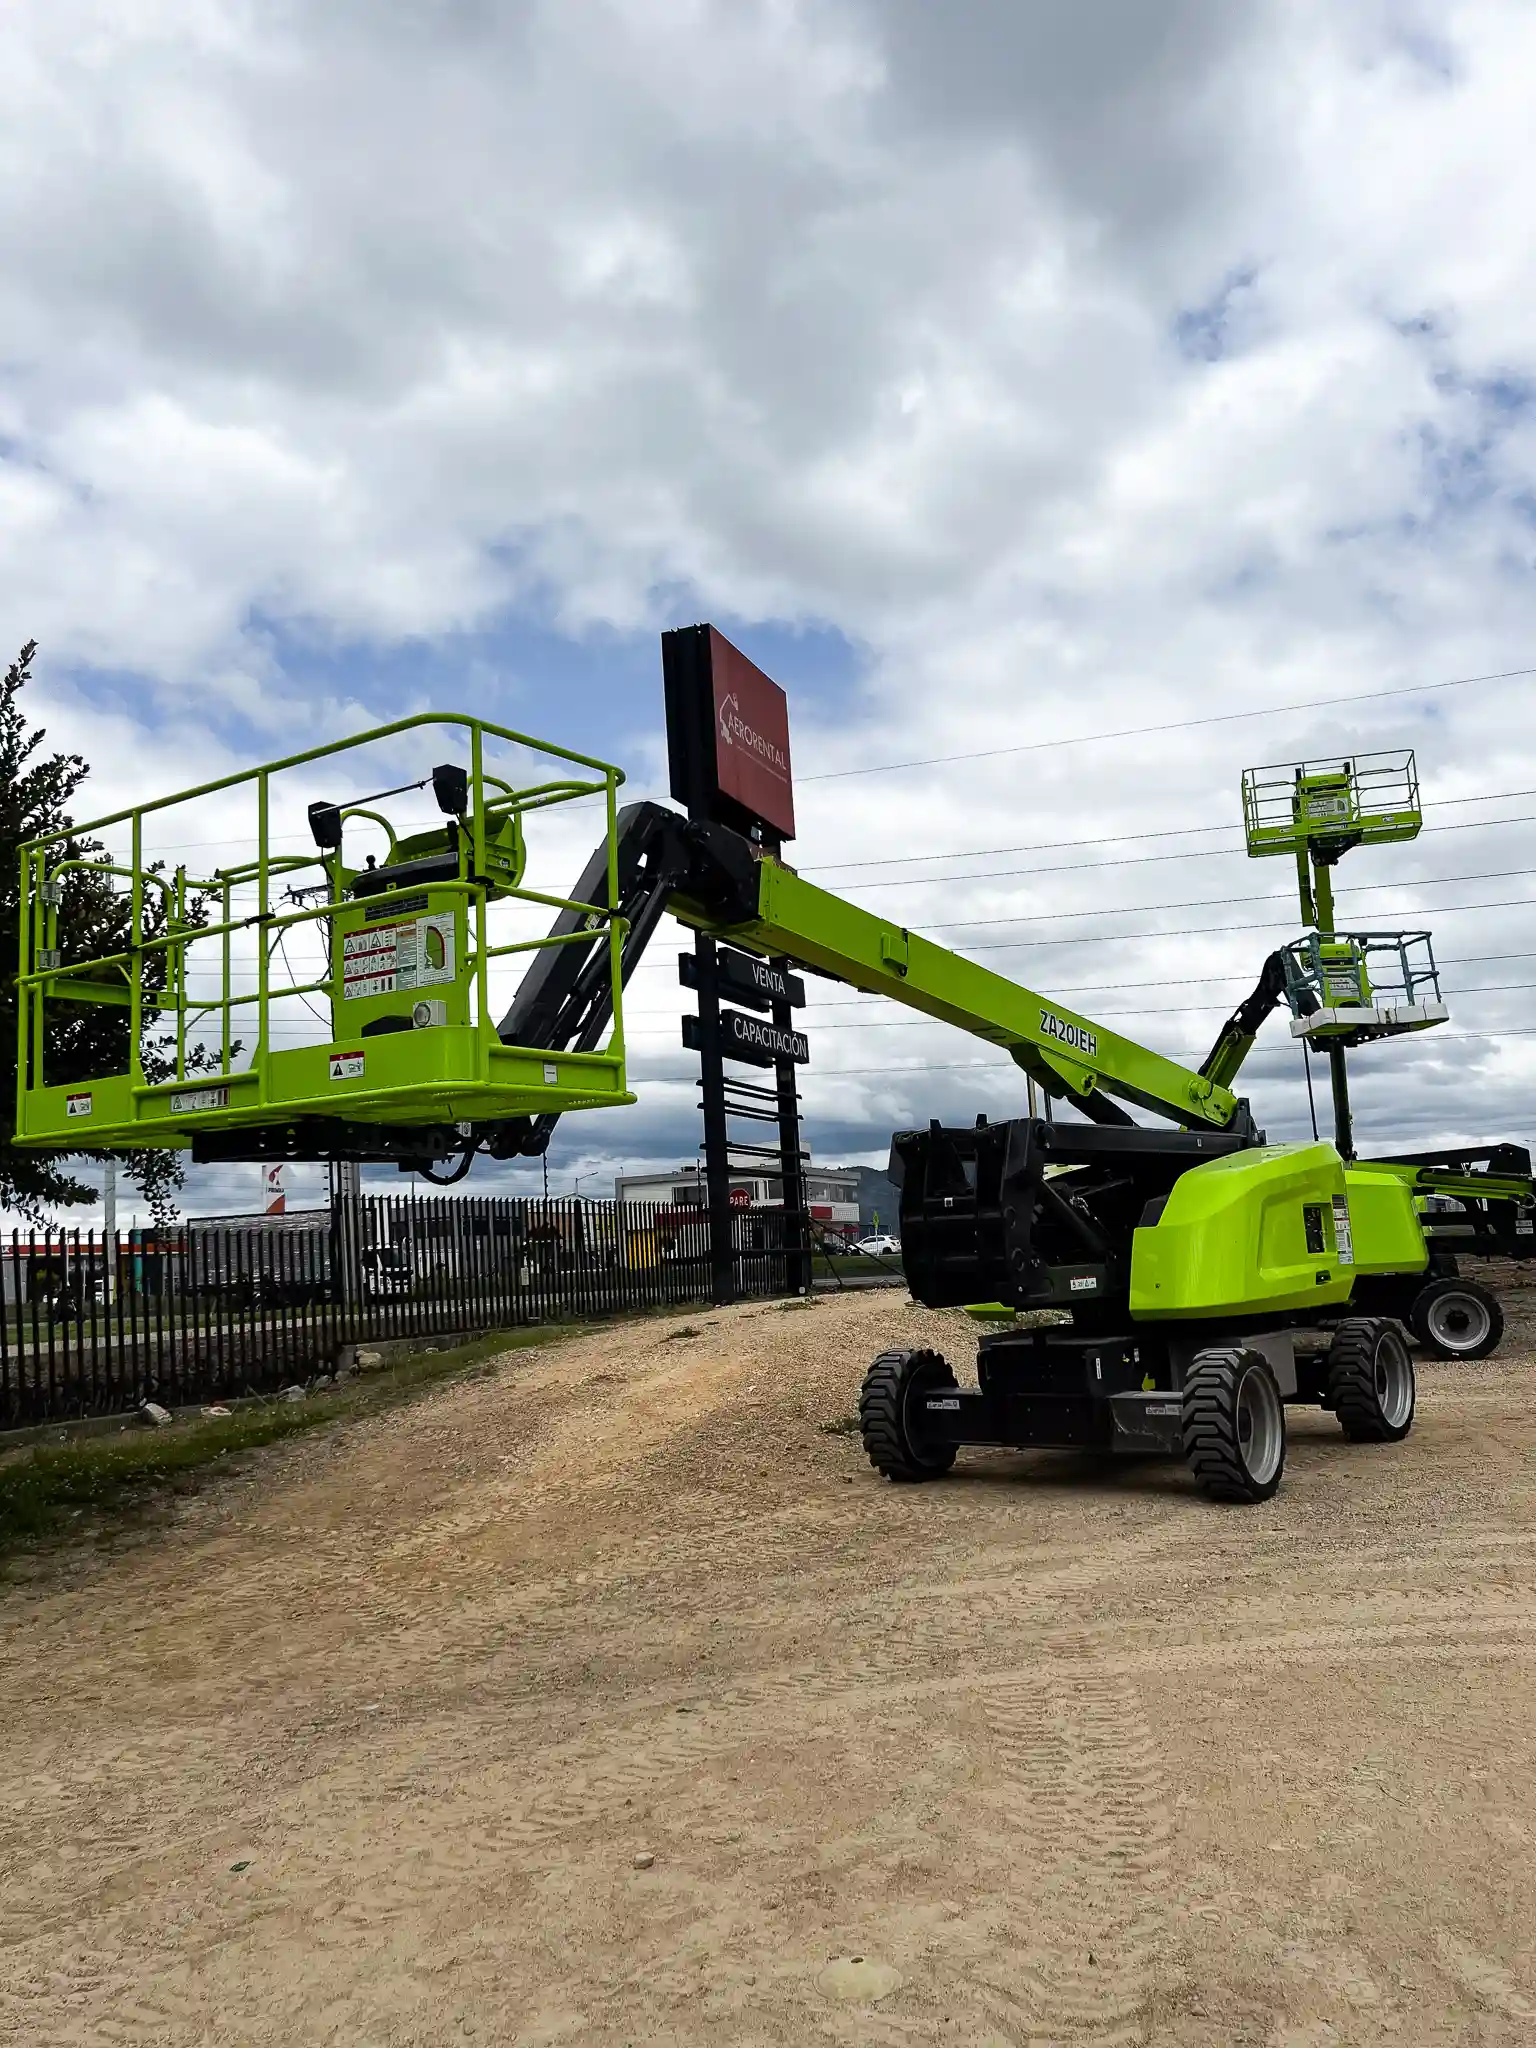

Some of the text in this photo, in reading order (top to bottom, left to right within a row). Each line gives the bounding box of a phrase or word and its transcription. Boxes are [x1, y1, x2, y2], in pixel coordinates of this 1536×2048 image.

[728, 711, 787, 771] AERORENTAL
[752, 963, 786, 995] VENTA
[734, 1017, 807, 1058] CAPACITACIÓN
[729, 1195, 749, 1206] PARE
